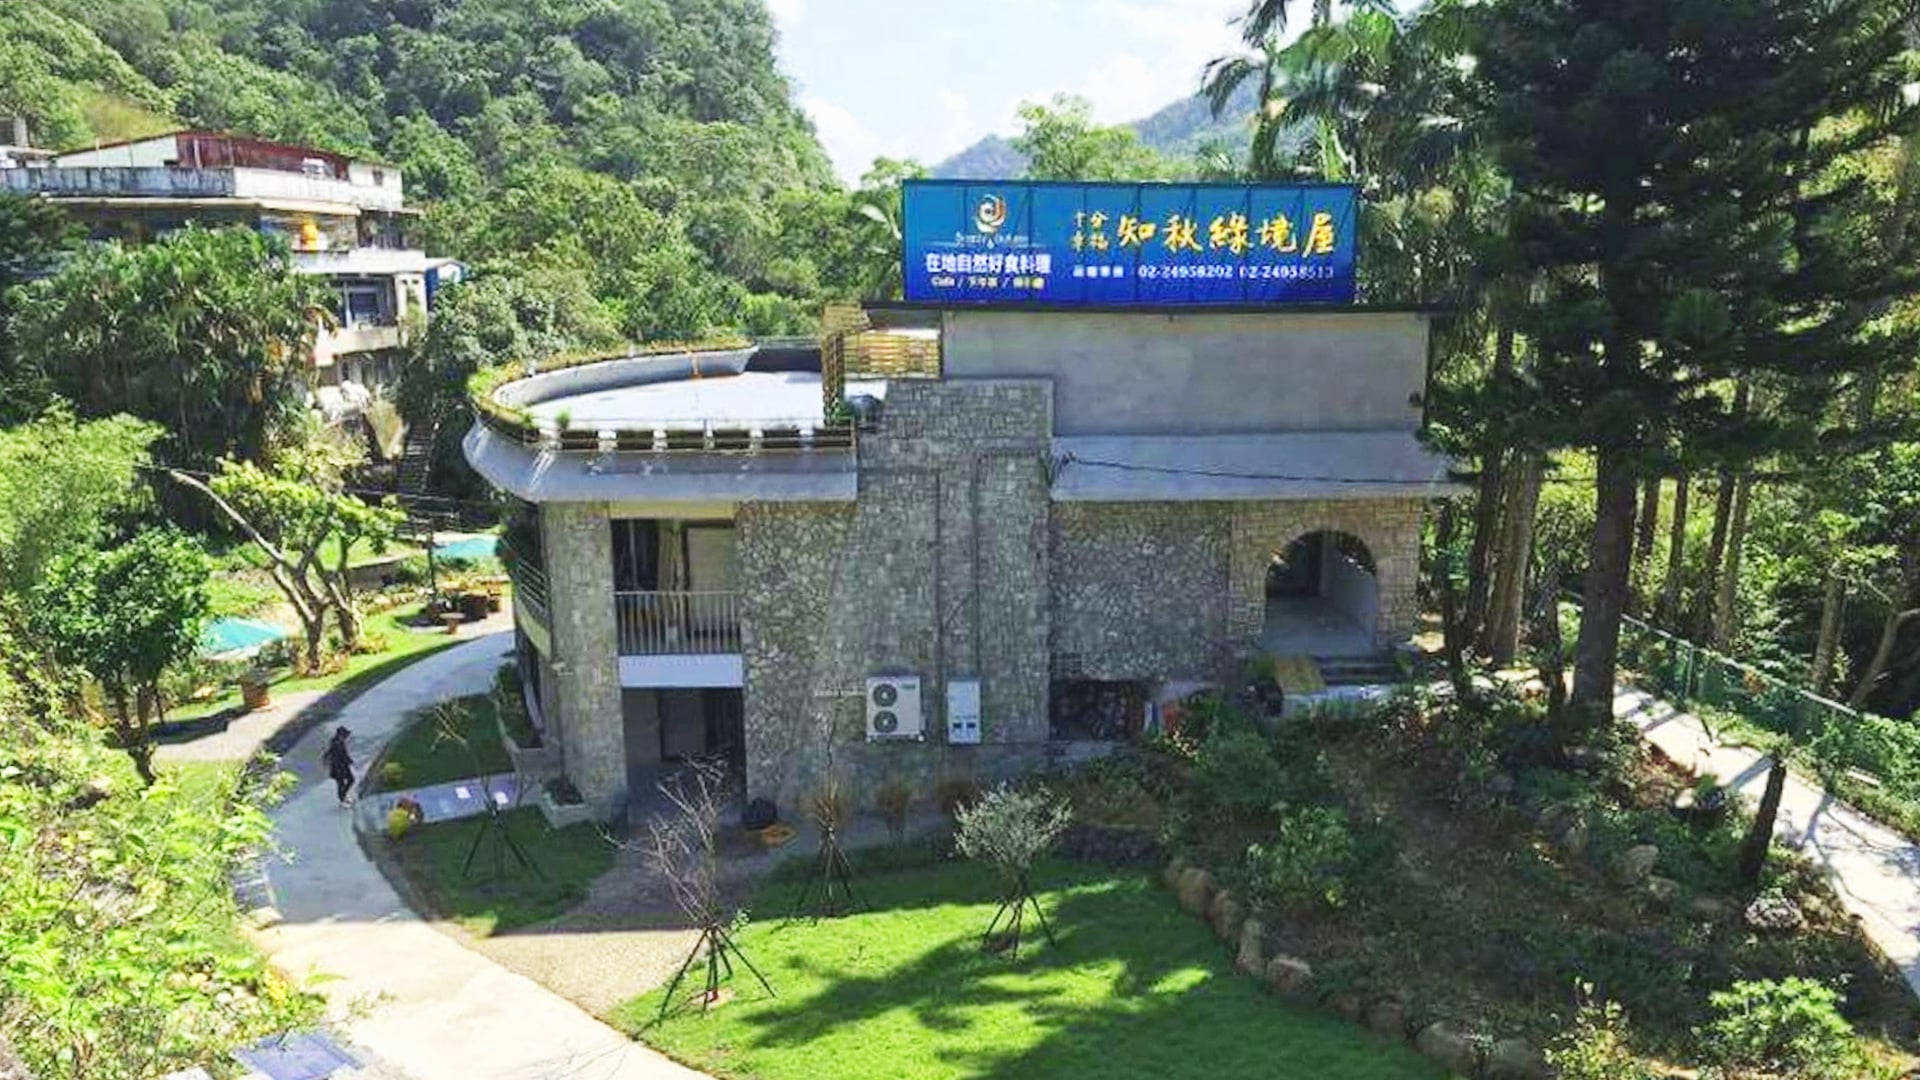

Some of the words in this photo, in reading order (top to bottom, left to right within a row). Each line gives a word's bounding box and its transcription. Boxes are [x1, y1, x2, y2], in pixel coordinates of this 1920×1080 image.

[926, 253, 1052, 274] 在地自然好食料理
